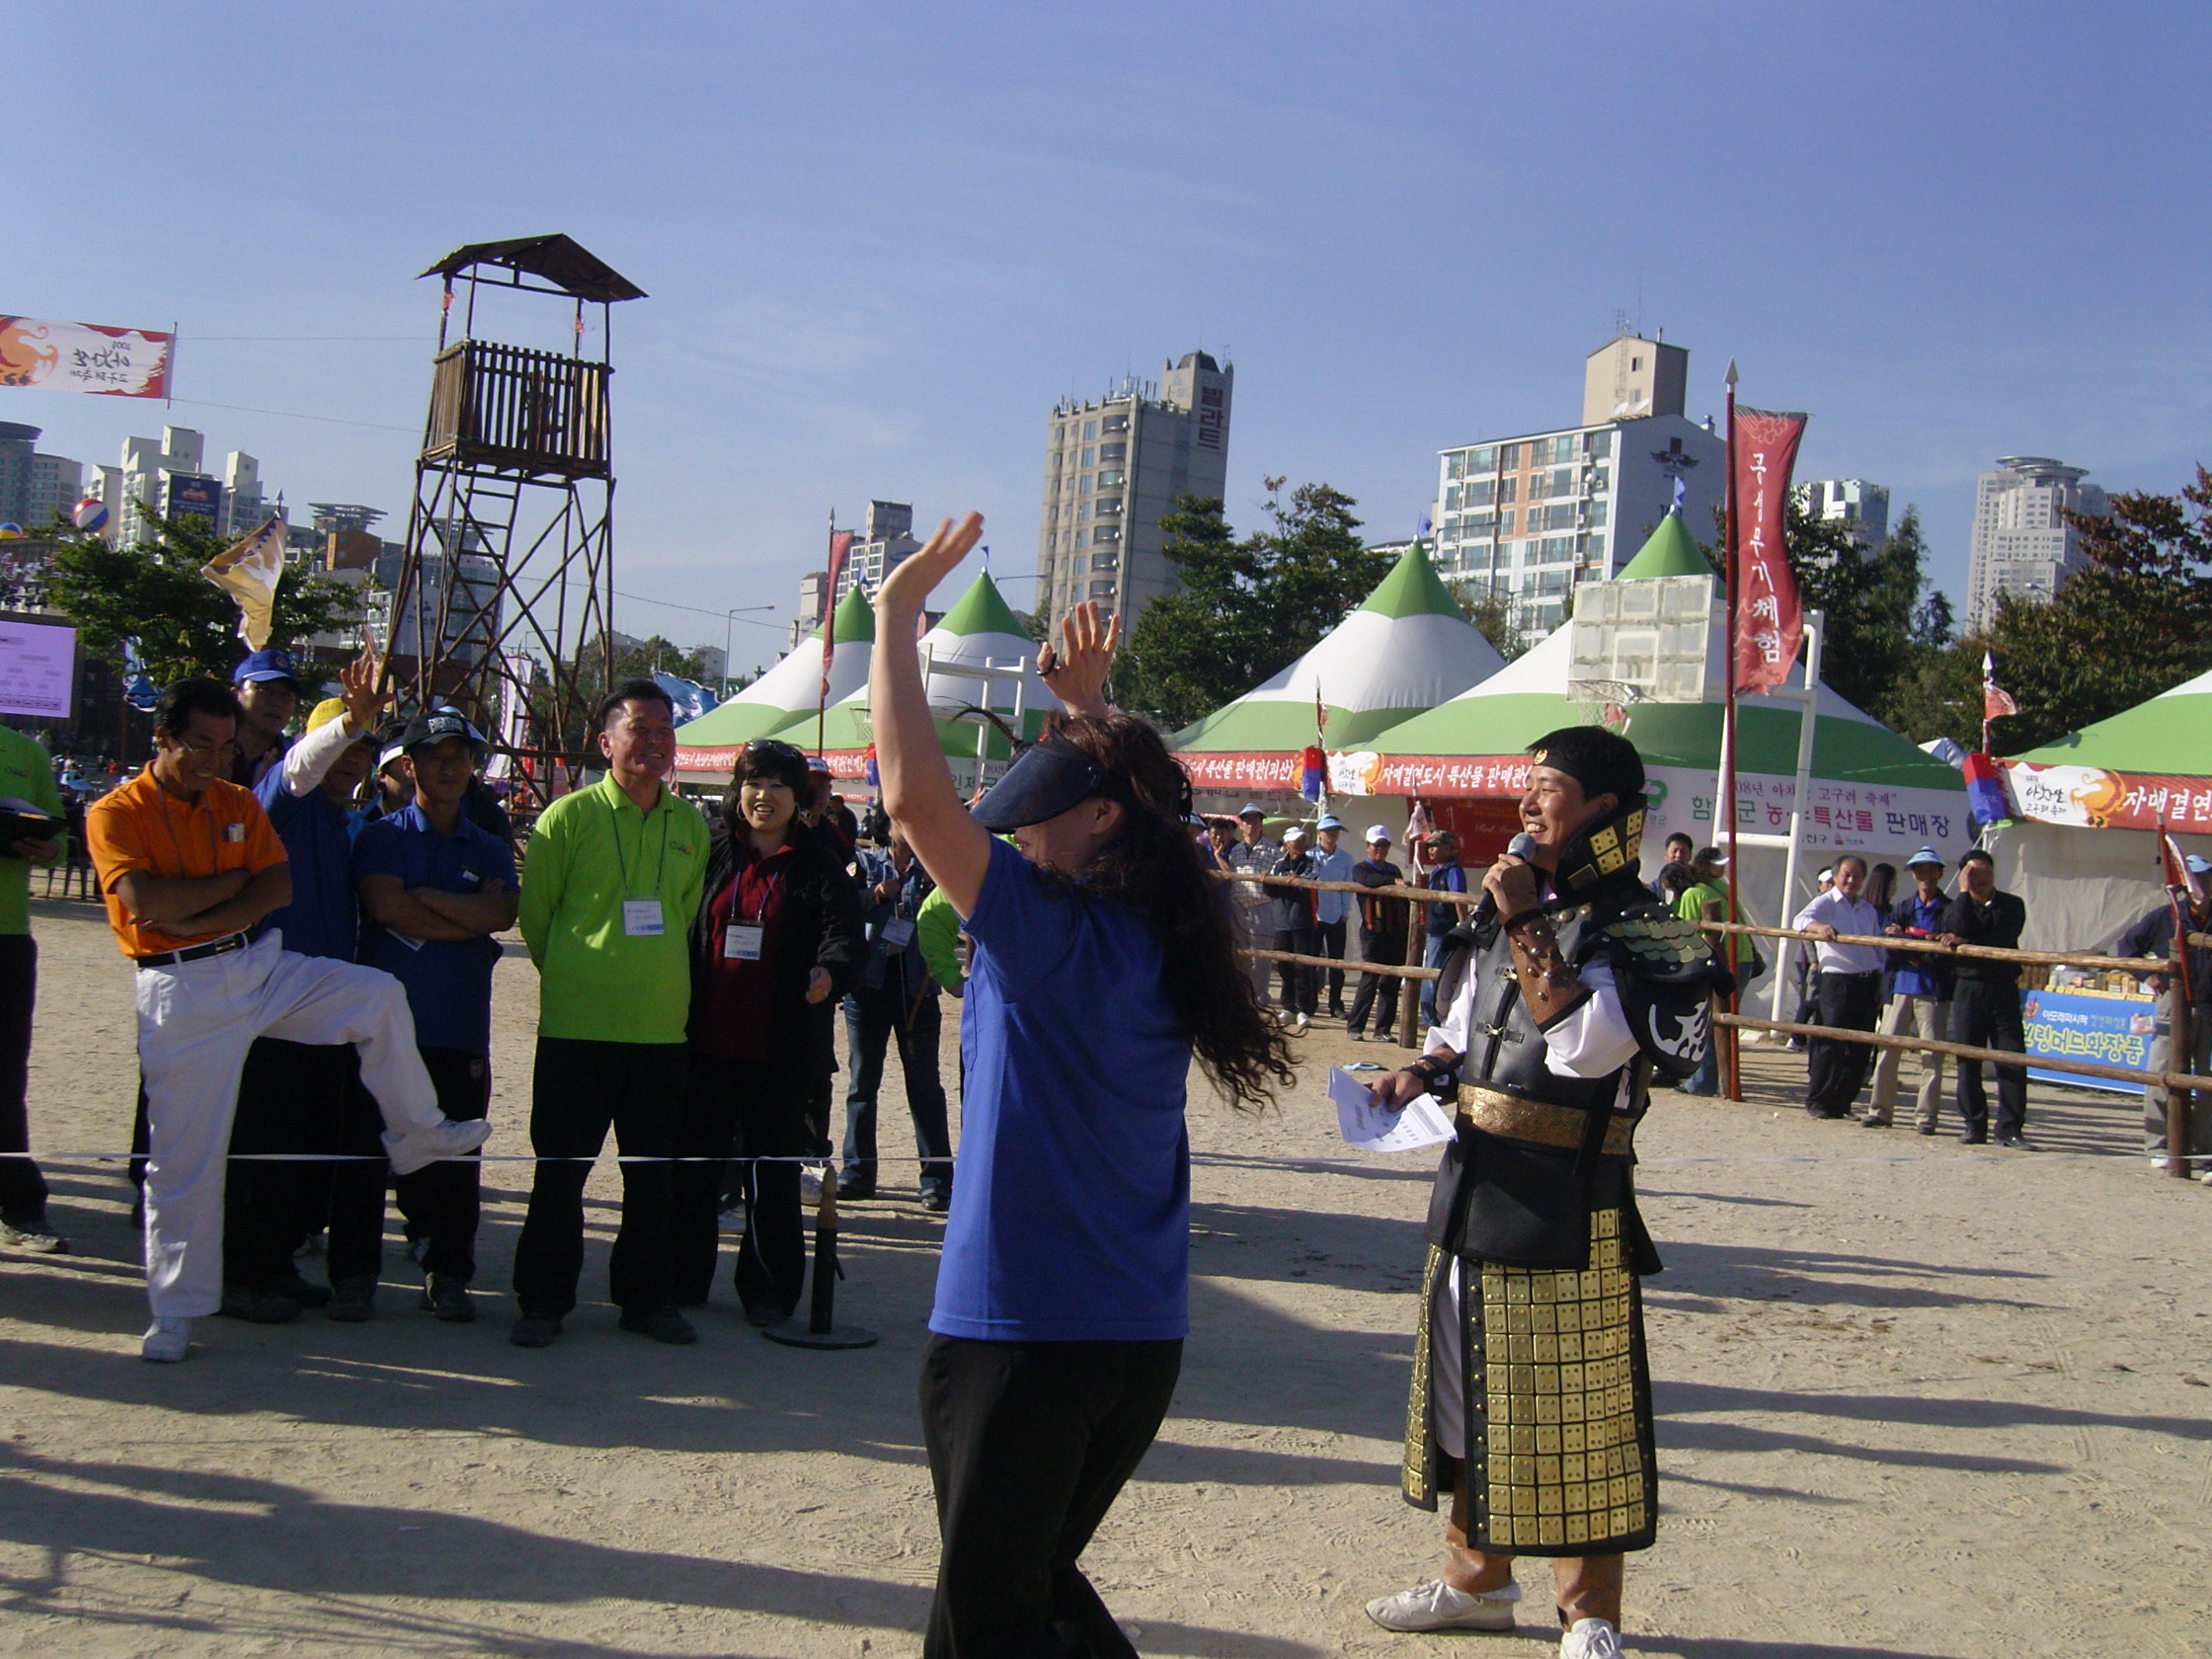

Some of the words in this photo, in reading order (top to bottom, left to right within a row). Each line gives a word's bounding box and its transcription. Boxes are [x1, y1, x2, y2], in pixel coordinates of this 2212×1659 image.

[1749, 452, 1781, 663] 공성무기체험
[1447, 764, 1483, 788] 특산물
[1773, 783, 1811, 802] 아차
[1819, 787, 1856, 805] 고구려
[1692, 796, 1756, 824] 함군
[1886, 812, 1951, 839] 판매장
